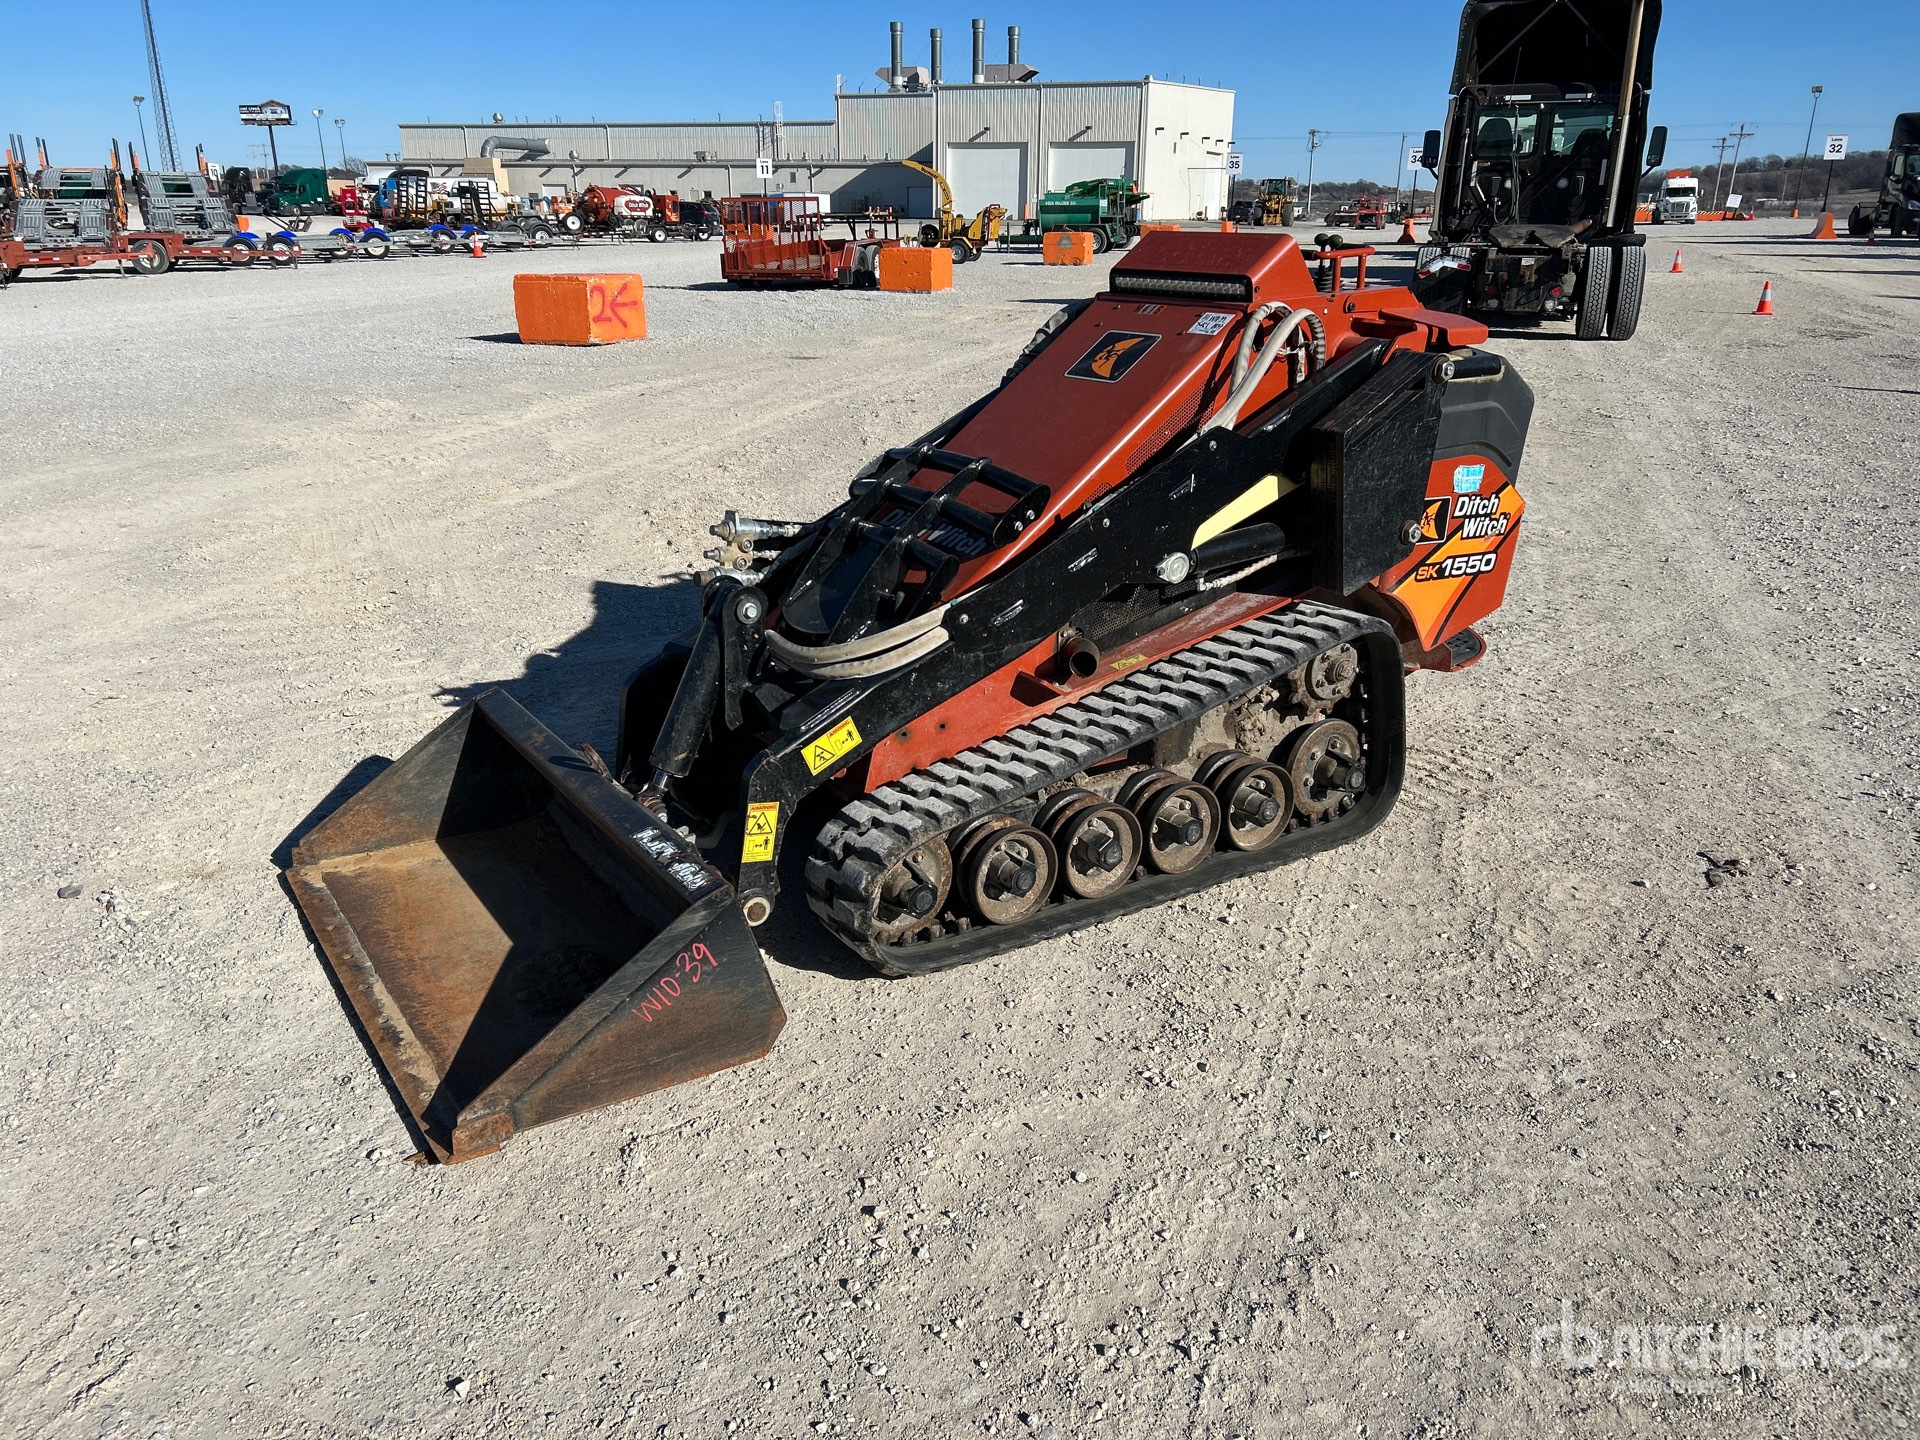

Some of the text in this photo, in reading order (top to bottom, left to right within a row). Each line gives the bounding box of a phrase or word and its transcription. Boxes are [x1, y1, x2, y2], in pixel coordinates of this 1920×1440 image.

[1829, 144, 1843, 153] 32
[761, 165, 769, 174] 11
[1229, 161, 1240, 169] 35
[1453, 494, 1499, 517] Ditch
[1462, 514, 1508, 538] Witch
[927, 523, 987, 556] Witch
